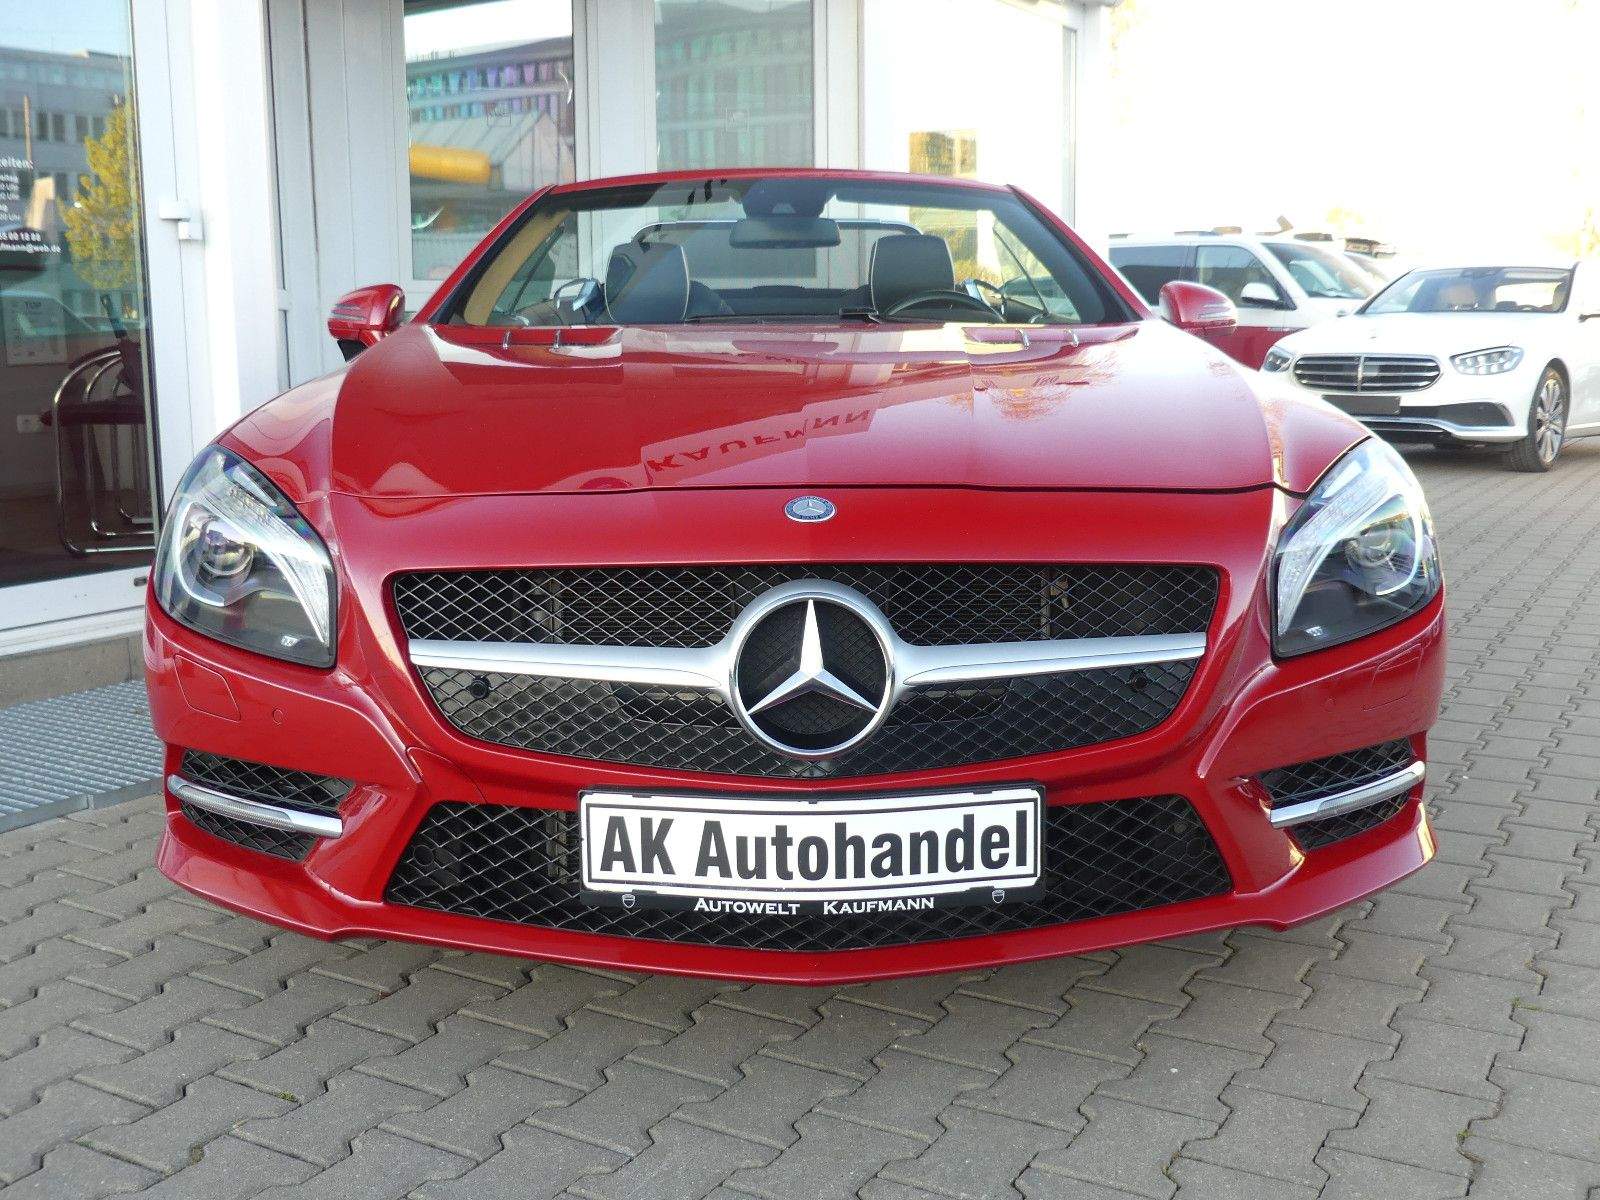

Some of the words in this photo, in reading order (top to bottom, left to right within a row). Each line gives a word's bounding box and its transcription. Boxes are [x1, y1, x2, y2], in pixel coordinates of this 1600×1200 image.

[600, 815, 676, 876] AK
[695, 810, 1028, 881] Autohandel
[694, 897, 800, 916] AUTOWELT
[823, 897, 935, 916] KAUFMANN
